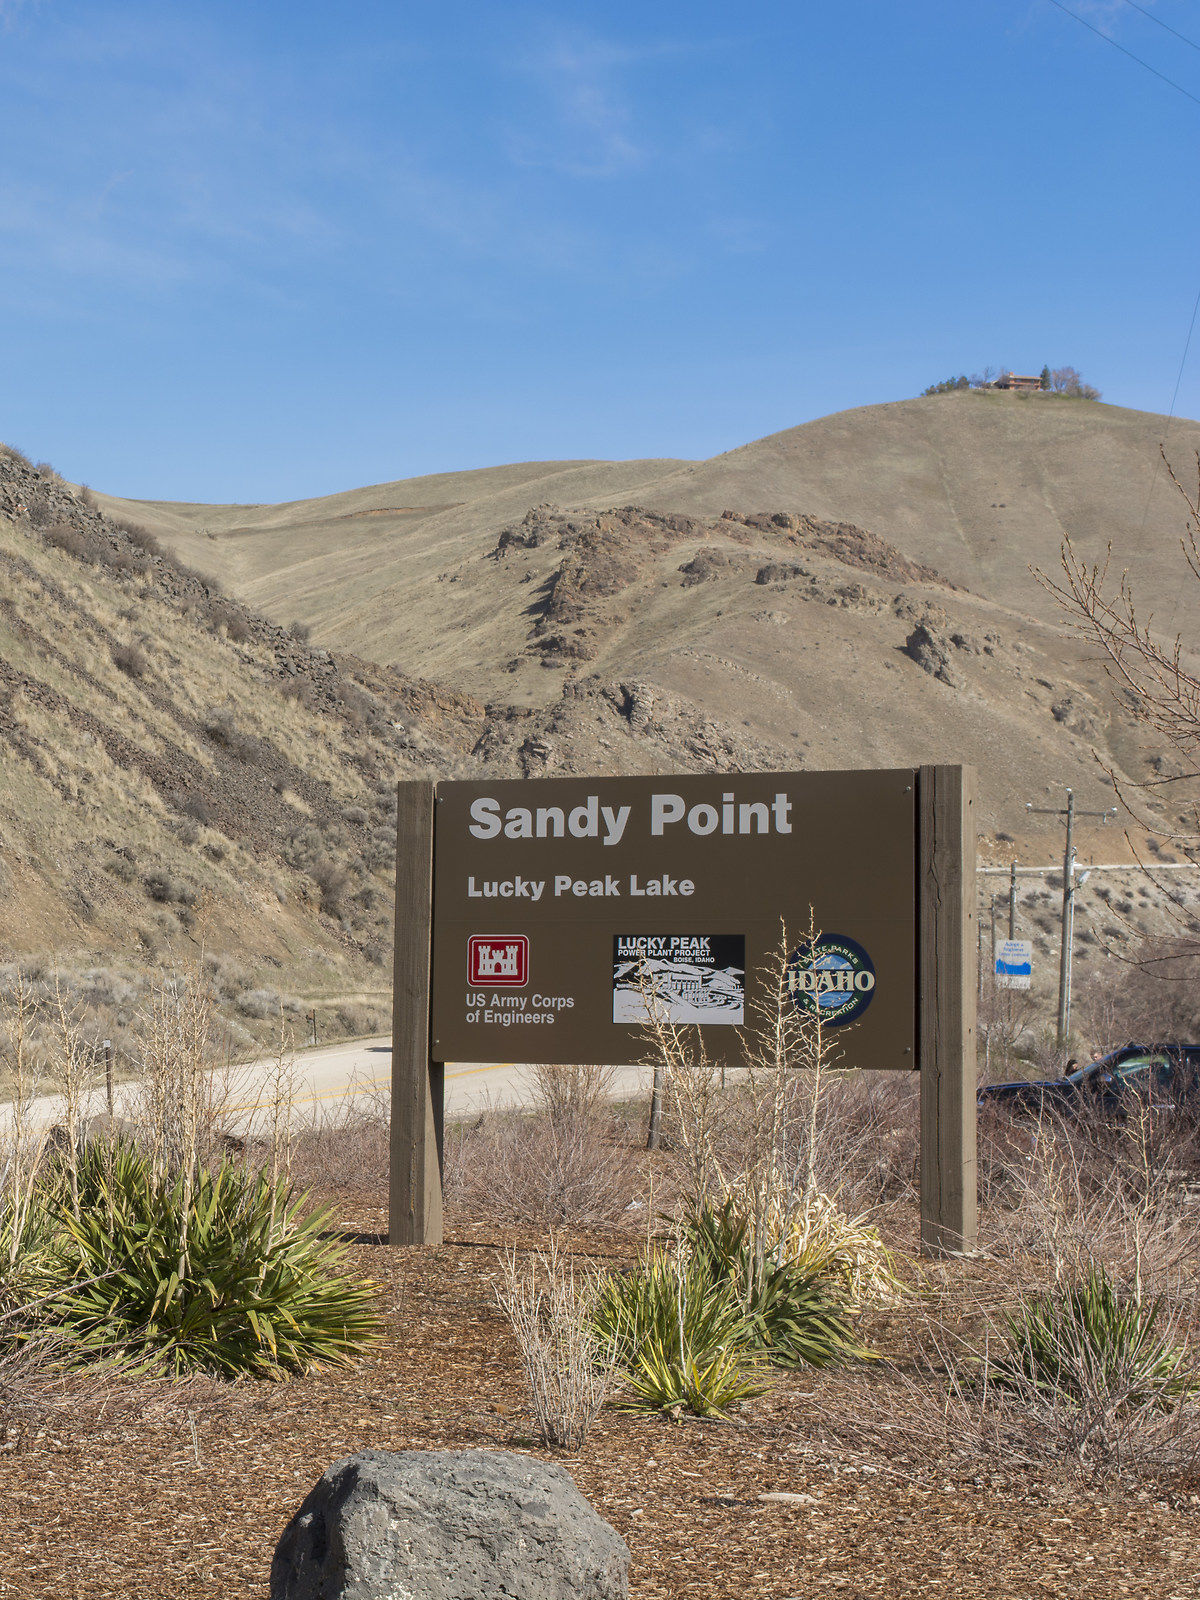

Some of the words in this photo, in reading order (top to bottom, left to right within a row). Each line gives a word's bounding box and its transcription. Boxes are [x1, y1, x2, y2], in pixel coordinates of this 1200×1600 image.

[469, 795, 631, 845] Sandy
[651, 792, 793, 836] Point
[468, 876, 545, 900] Lucky
[554, 875, 620, 897] Peak
[630, 874, 695, 896] Lake
[618, 937, 667, 949] LUCKY
[670, 936, 711, 949] PEAK
[618, 949, 646, 957] POWER
[647, 949, 674, 957] PLANT
[675, 949, 711, 957] PROJECT
[831, 945, 859, 965] PARKS
[787, 970, 876, 992] IDAHO
[466, 993, 486, 1007] US
[490, 993, 527, 1010] Army
[532, 994, 575, 1011] Corps
[466, 1010, 480, 1023] of
[484, 1010, 555, 1027] Engineers
